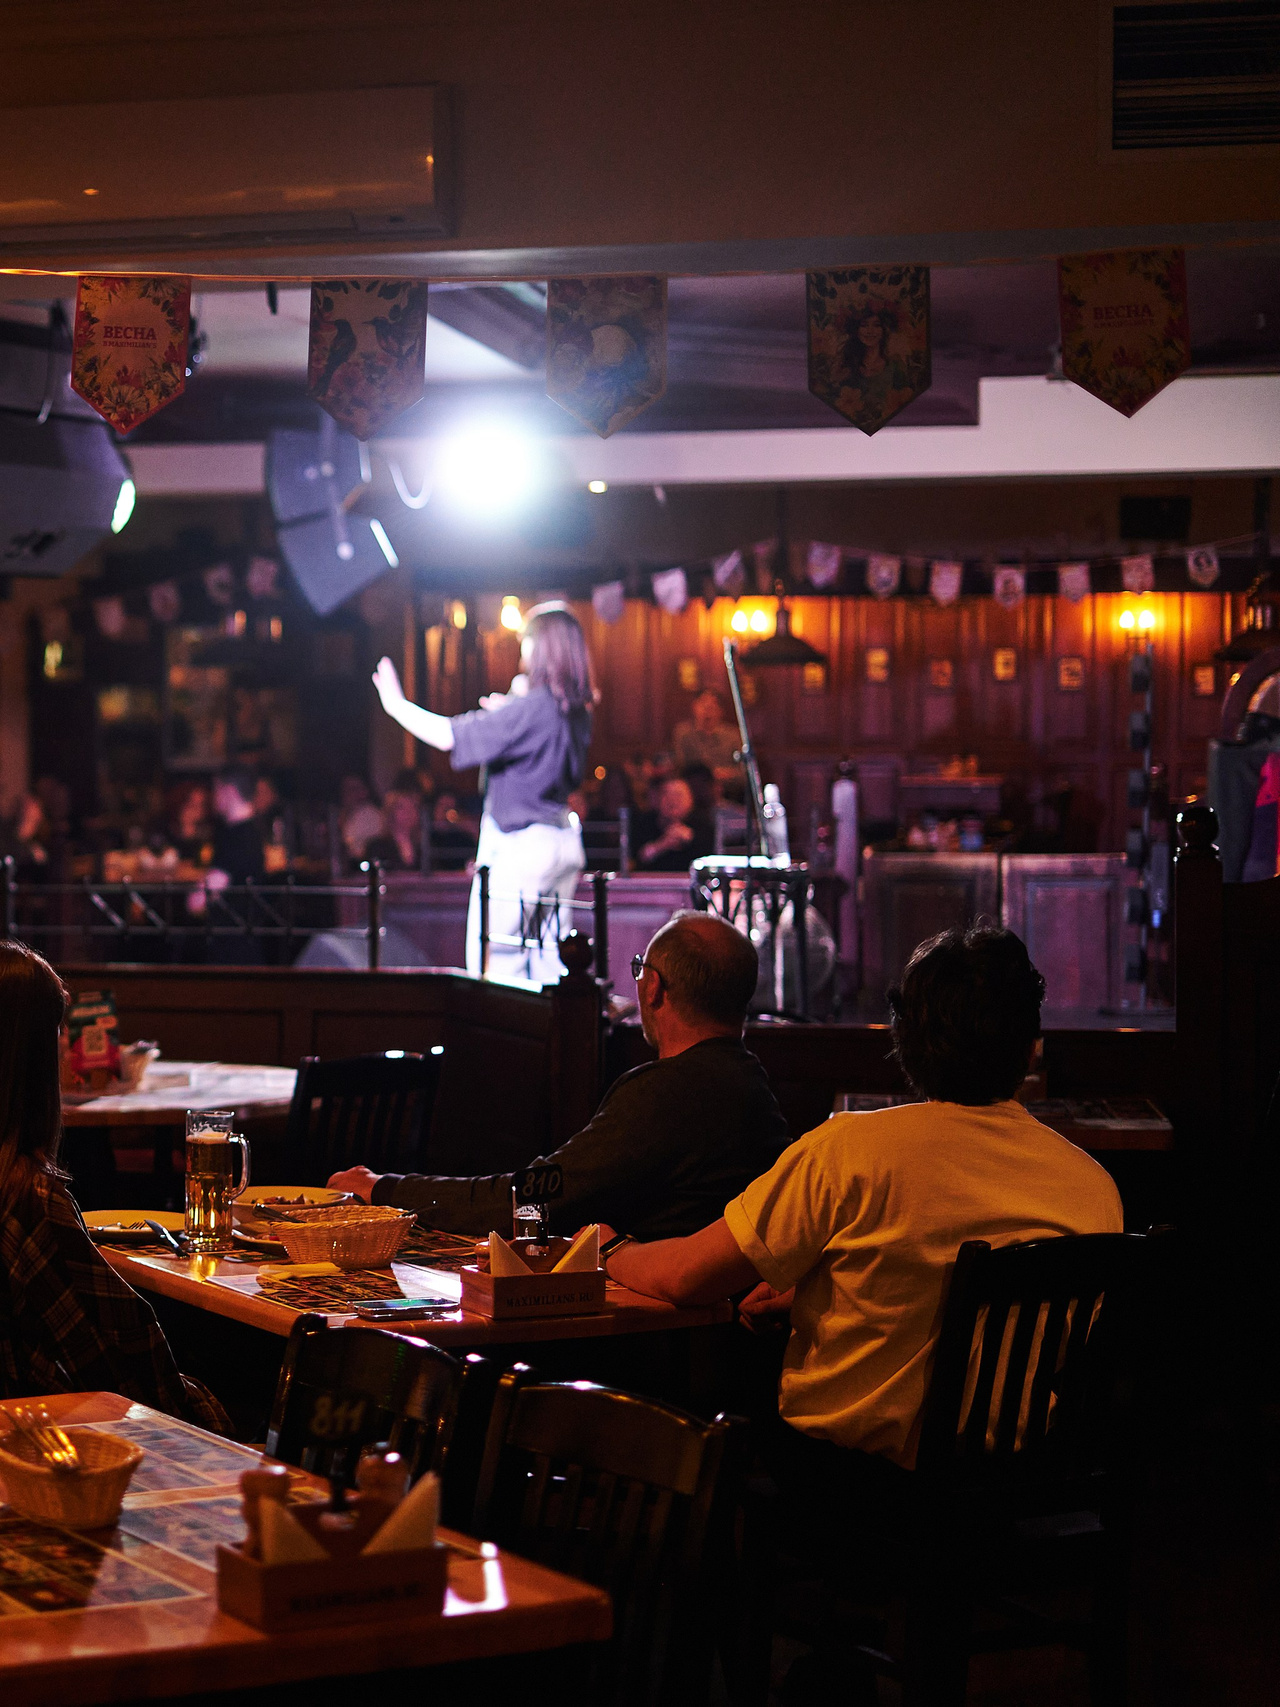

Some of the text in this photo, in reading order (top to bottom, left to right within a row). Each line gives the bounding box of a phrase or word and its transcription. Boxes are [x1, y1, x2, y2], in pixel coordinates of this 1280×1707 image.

[1093, 303, 1154, 320] ВЕСНА
[103, 326, 157, 340] ВЕСНА
[522, 1170, 561, 1197] 810
[308, 1394, 367, 1437] 811
